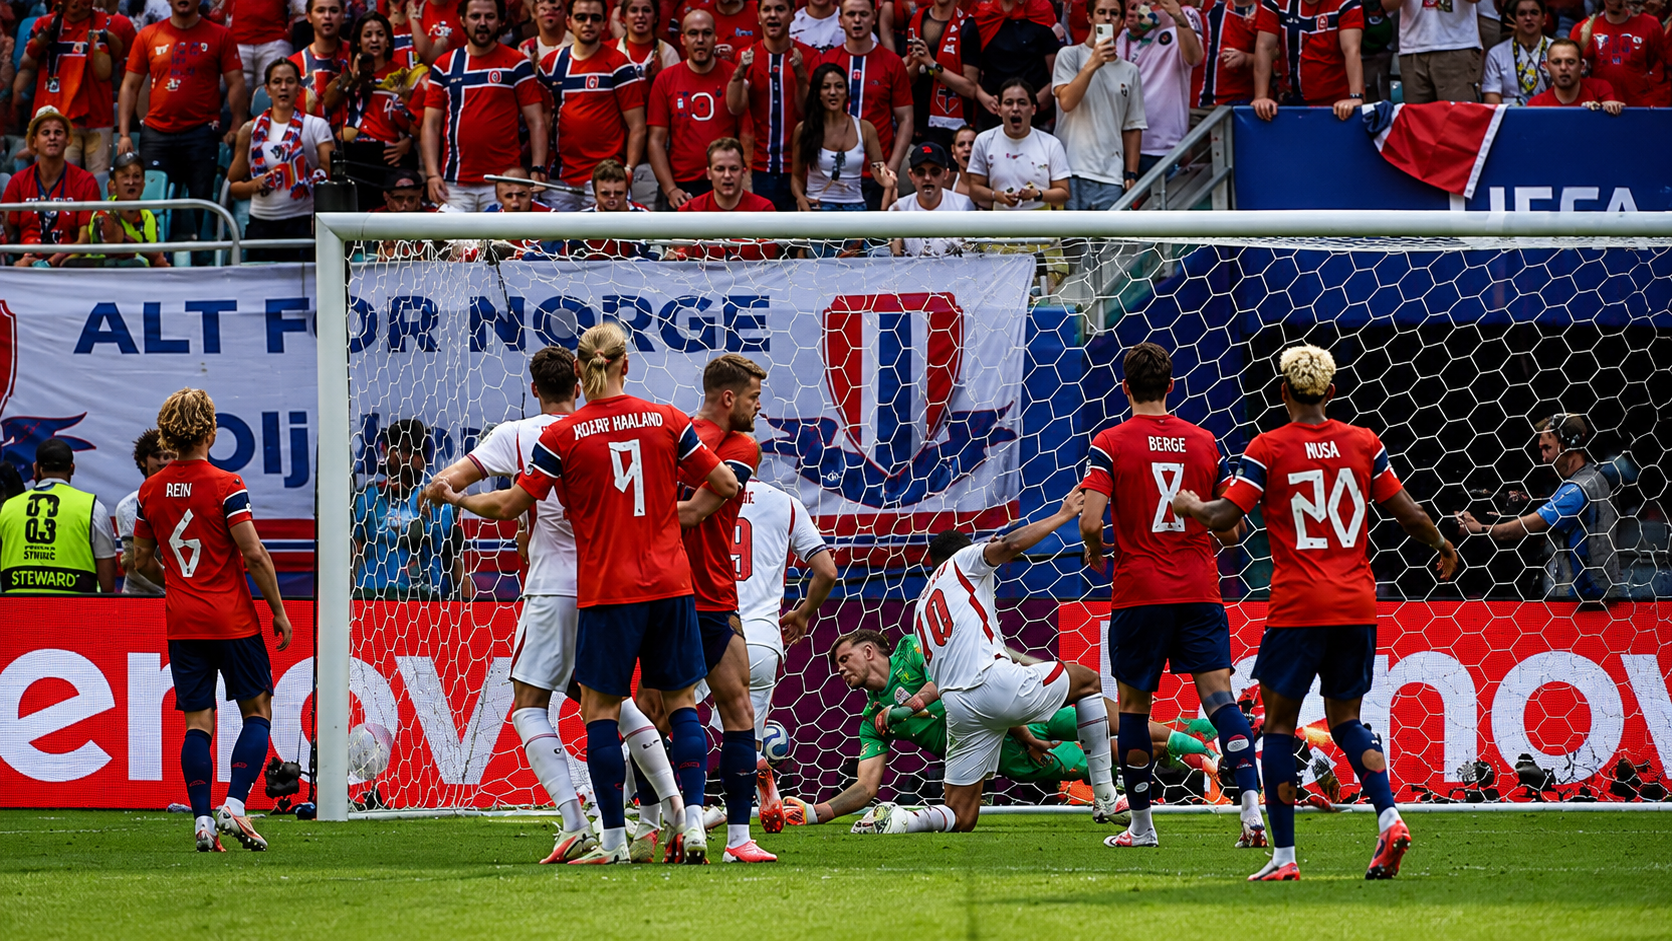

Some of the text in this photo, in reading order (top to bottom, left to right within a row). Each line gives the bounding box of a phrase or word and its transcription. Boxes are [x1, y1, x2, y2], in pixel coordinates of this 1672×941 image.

[73, 300, 239, 354] ALT
[469, 295, 771, 353] NORGE
[612, 411, 663, 431] HAALAND
[1148, 436, 1187, 453] BERGE
[1305, 440, 1341, 459] NUSA
[165, 482, 192, 497] REIN
[608, 439, 646, 517] 9
[1151, 462, 1186, 533] 8
[1287, 467, 1366, 550] 20
[168, 508, 202, 578] 6
[11, 570, 77, 588] STEWARD
[915, 588, 955, 667] 10
